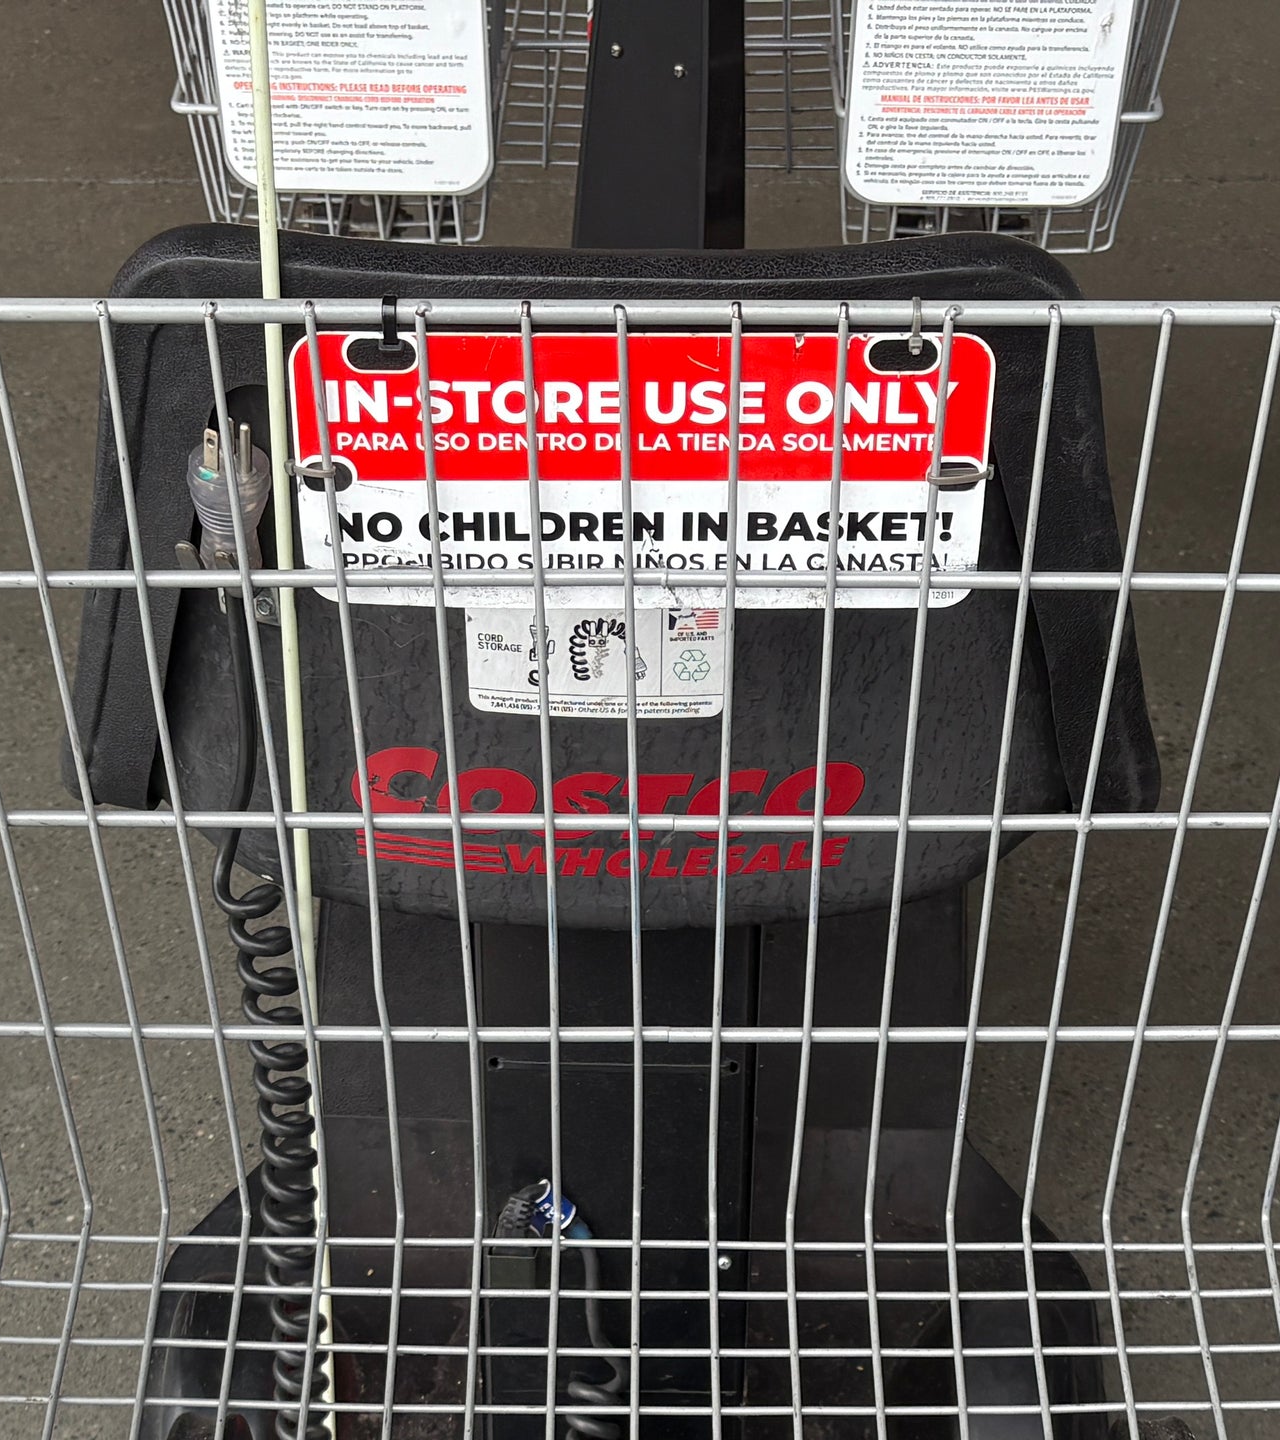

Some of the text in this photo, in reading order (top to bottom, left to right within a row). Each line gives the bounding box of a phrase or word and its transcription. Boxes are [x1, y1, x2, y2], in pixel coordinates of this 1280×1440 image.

[339, 83, 367, 92] PLEASE
[369, 84, 389, 92] READ
[392, 84, 421, 93] BEFORE
[423, 85, 467, 94] OPERATING
[324, 380, 959, 424] IN-STORE USE ONLY
[337, 432, 408, 451] PARA
[416, 432, 470, 452] USO
[478, 432, 587, 452] DENTRO
[638, 433, 672, 451] LA
[678, 433, 776, 452] TIENDA
[782, 433, 936, 452] SOLAMENTE
[337, 512, 954, 542] NO CHILDREN IN BASKET!
[518, 553, 604, 570] SUBIR
[614, 548, 704, 570] NIÑOS
[714, 554, 751, 570] EN
[762, 554, 797, 570] LA
[806, 554, 948, 571] CANASTA!
[478, 632, 504, 642] CORD
[478, 641, 522, 653] STORAGE
[350, 746, 866, 841] COSTCO
[504, 835, 850, 878] WHOLESALE
